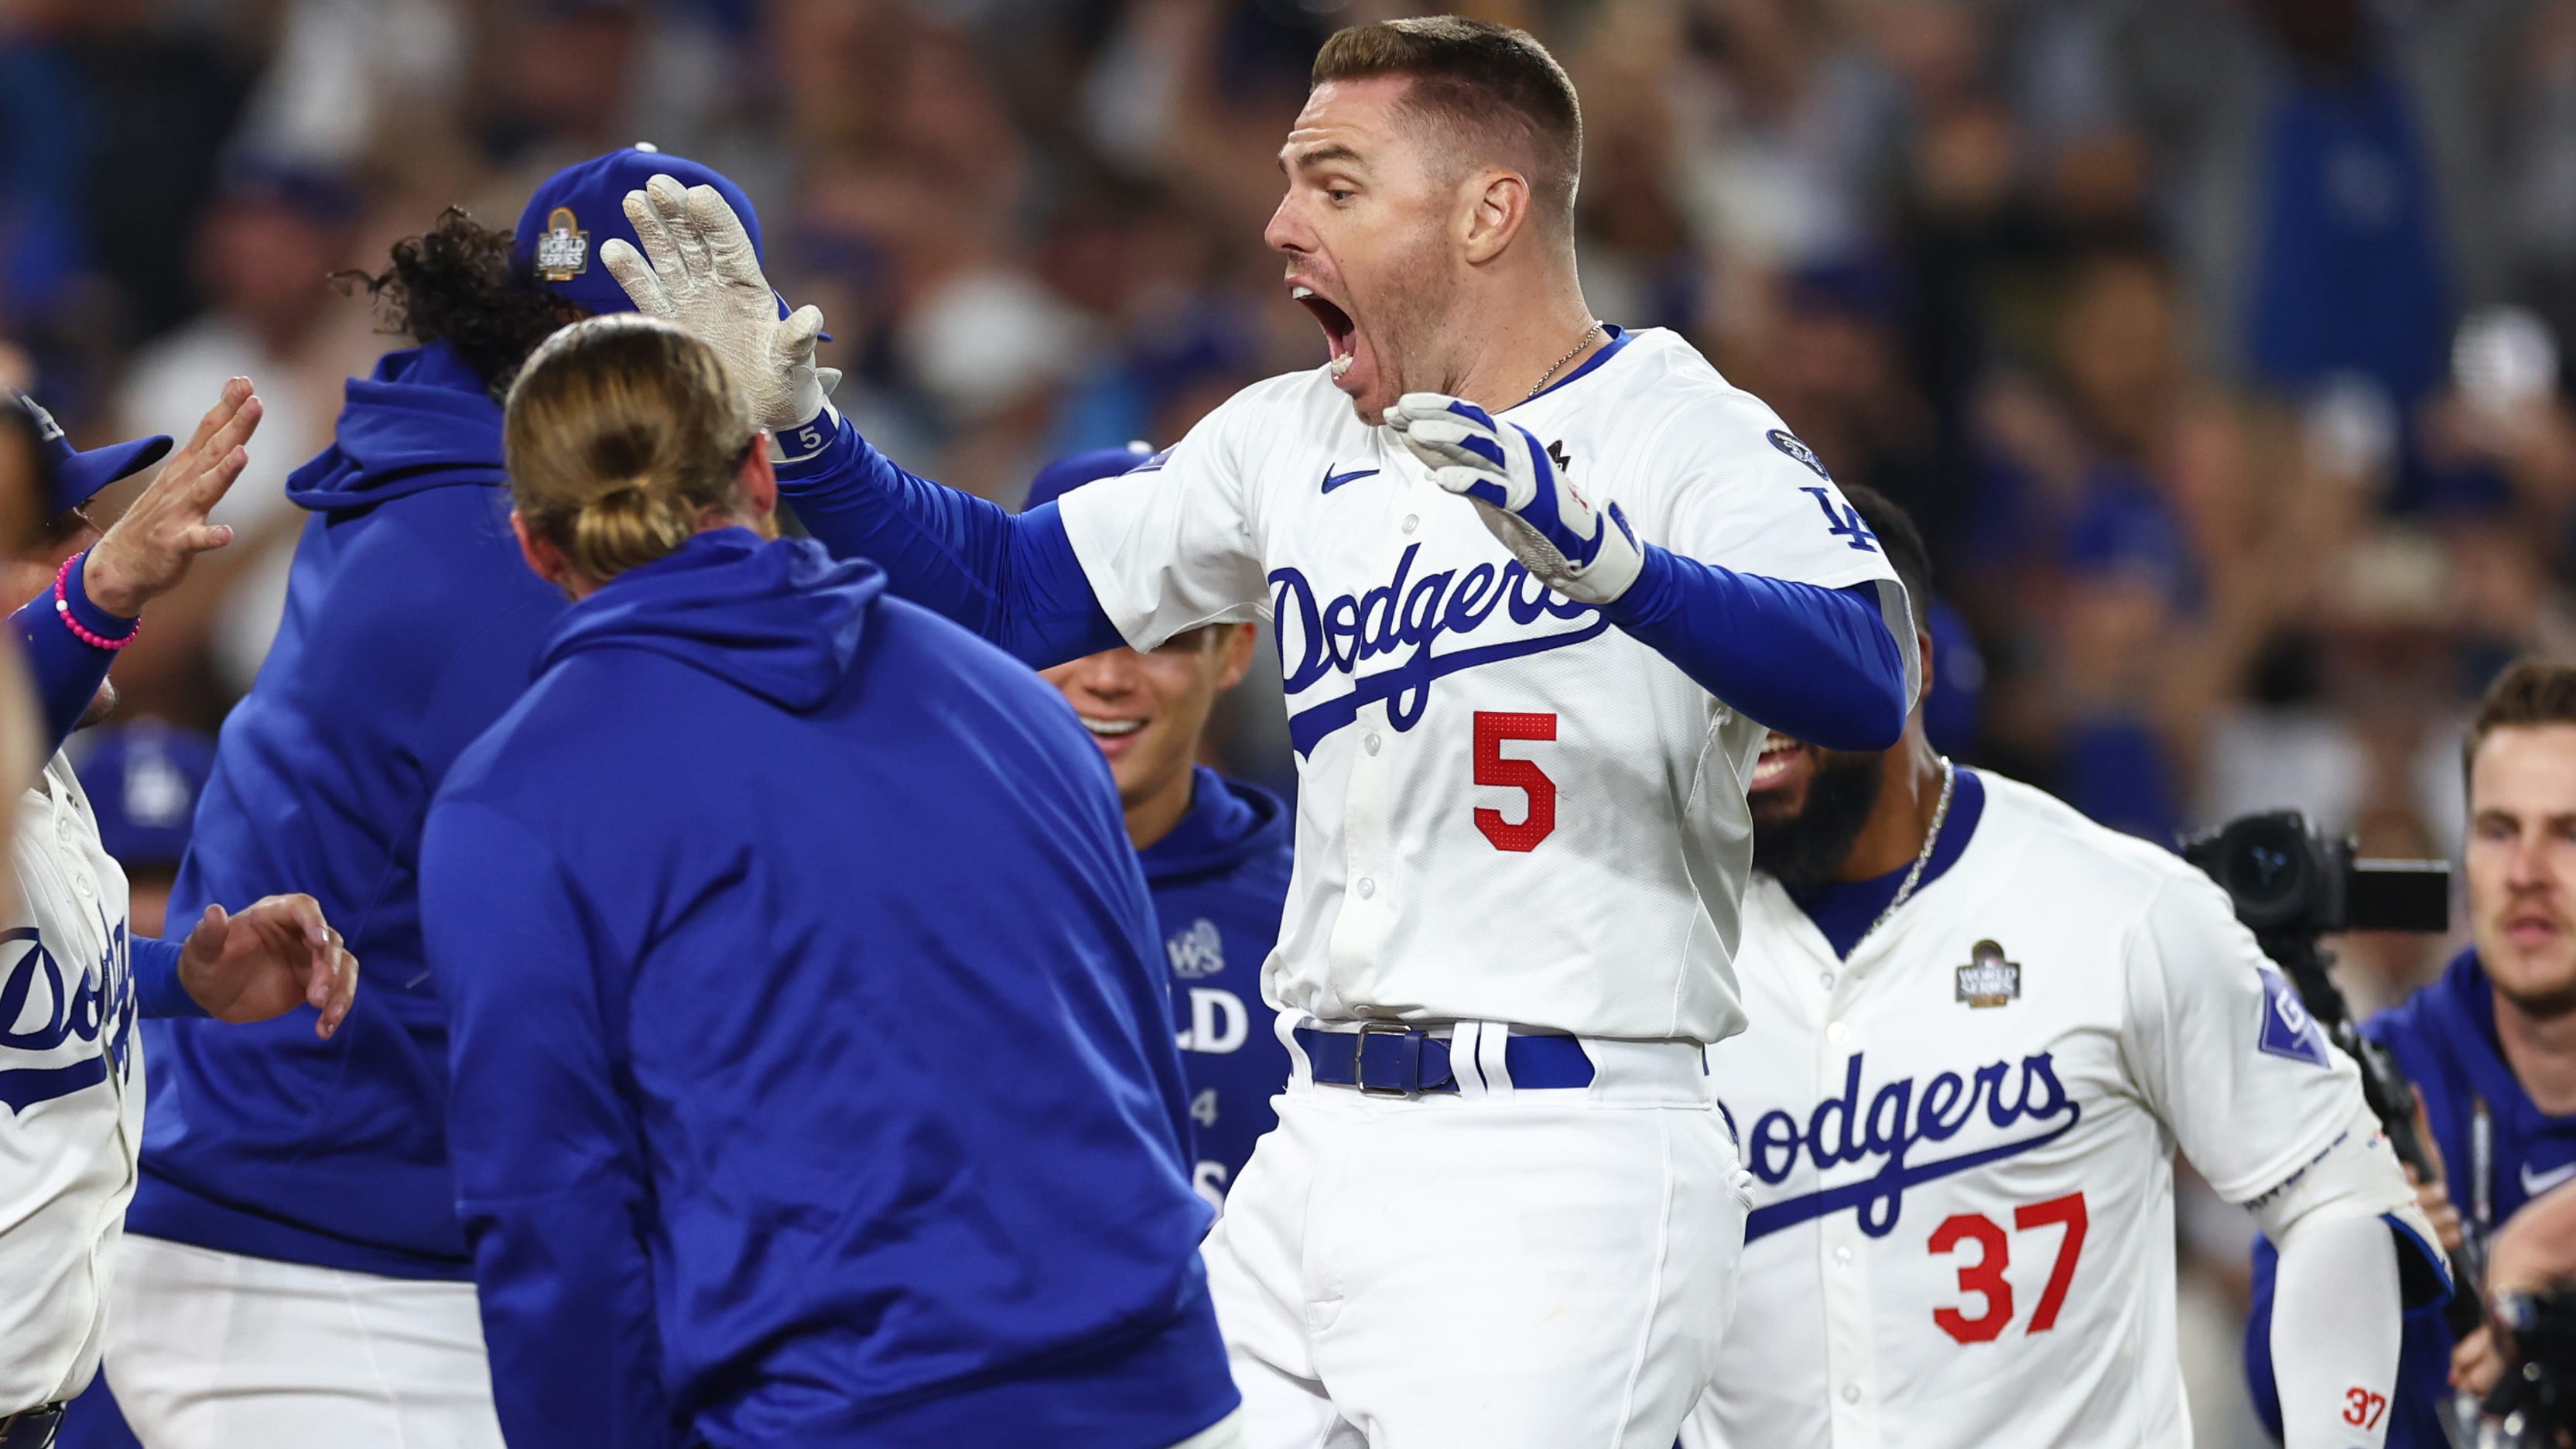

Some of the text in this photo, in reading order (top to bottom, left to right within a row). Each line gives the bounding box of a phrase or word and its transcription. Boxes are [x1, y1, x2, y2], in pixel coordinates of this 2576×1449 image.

[799, 425, 822, 449] 5
[1798, 487, 1878, 553] LA
[1473, 711, 1557, 852] 5
[2276, 988, 2305, 1034] G
[1718, 1051, 2080, 1239] odgers
[1928, 1191, 2089, 1345] 37
[2343, 1387, 2386, 1431] 37
